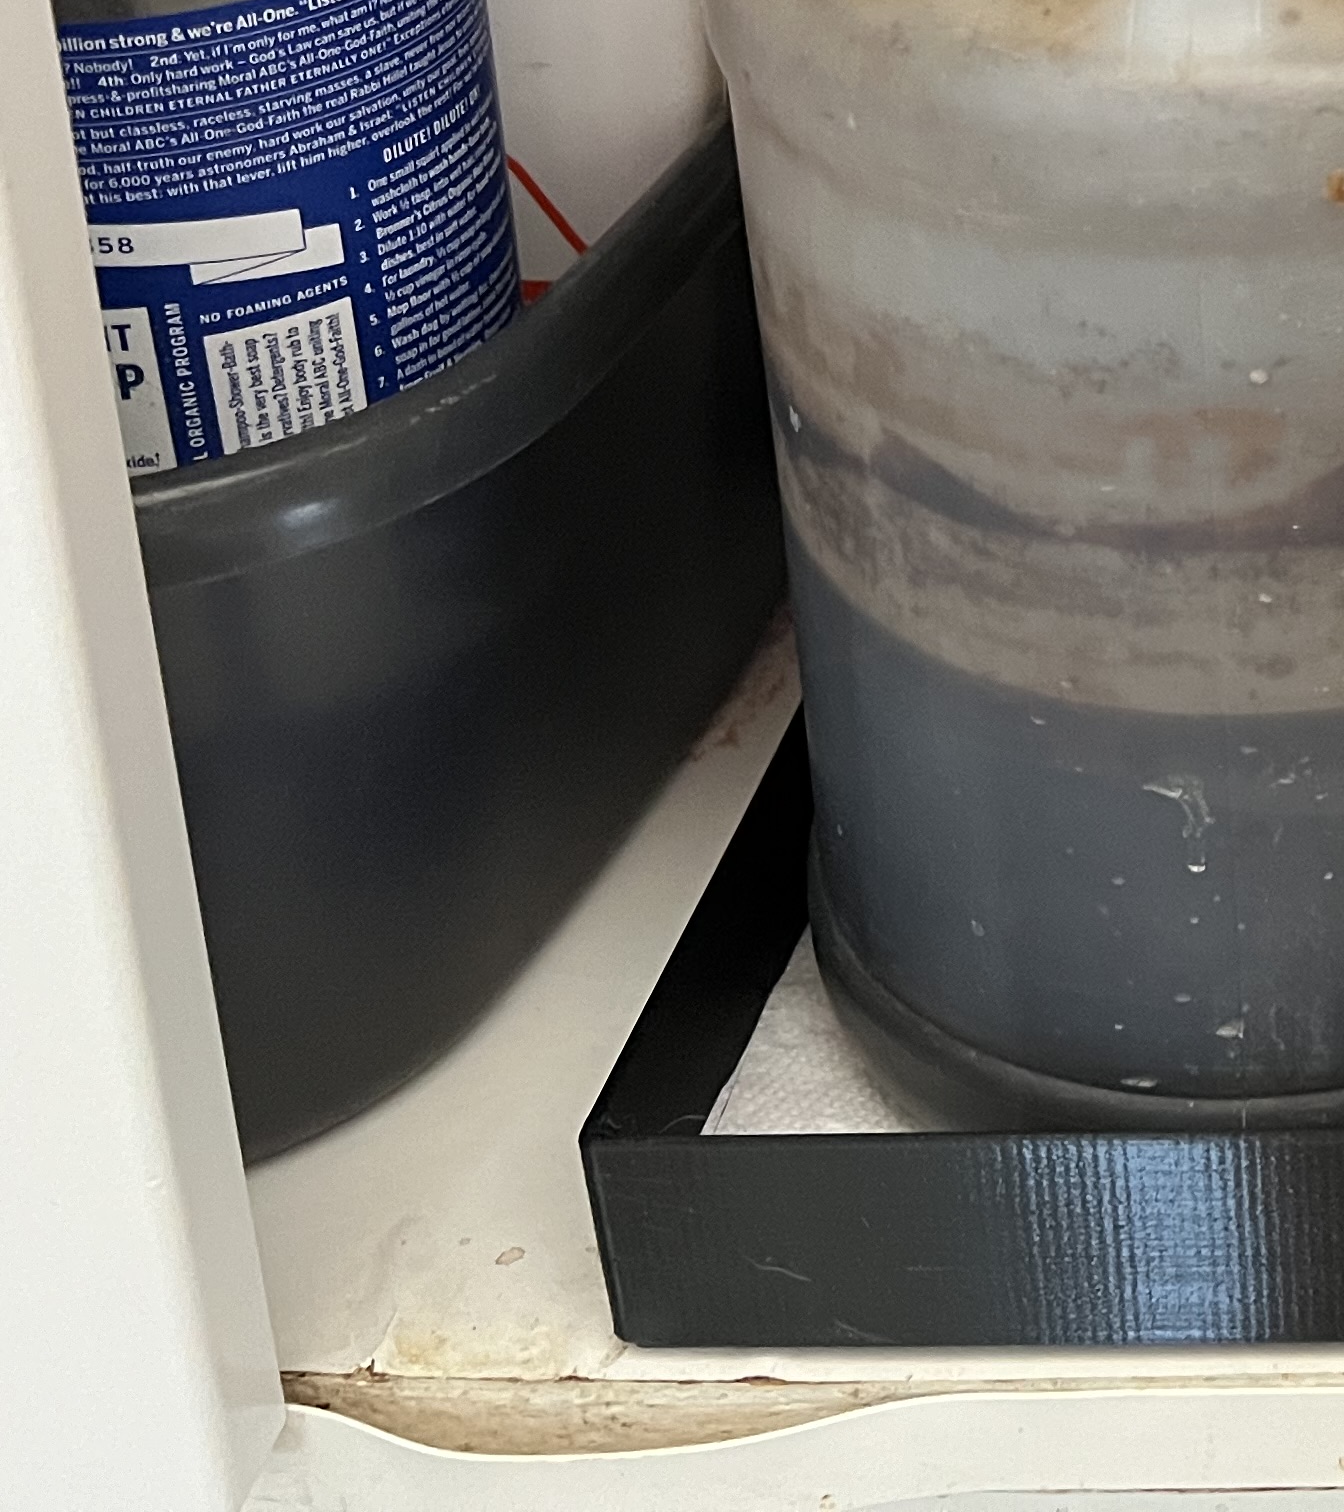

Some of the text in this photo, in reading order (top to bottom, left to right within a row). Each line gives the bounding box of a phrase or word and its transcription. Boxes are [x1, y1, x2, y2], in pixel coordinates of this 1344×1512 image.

[73, 59, 133, 74] Nobody!
[248, 35, 275, 53] only
[278, 30, 294, 43] for
[321, 9, 349, 29] what
[351, 4, 367, 19] am
[110, 33, 168, 47] strong
[171, 28, 185, 41] &
[187, 21, 233, 39] we're
[237, 5, 299, 30] All-One.
[131, 5, 396, 88] Only hard work God's Law can save but
[90, 54, 357, 118] CHILDREN ETERNAL FATHER ETERNALLY
[218, 59, 297, 88] Moral ABC's
[90, 127, 114, 140] but
[258, 89, 313, 114] starving
[91, 77, 381, 154] Moral ABC's the real Rabbi
[383, 127, 431, 163] DILUTE!
[433, 98, 469, 135] DILUTE!
[99, 189, 122, 203] his
[167, 180, 199, 197] with
[203, 176, 232, 191] that
[277, 157, 297, 174] lift
[300, 153, 325, 167] him
[372, 114, 416, 142] overlook
[155, 124, 357, 187] years astronomers Abraham &
[178, 116, 345, 165] our hard work our
[350, 160, 415, 199] 1. One small
[372, 207, 398, 223] Work
[377, 235, 406, 255] Dilute
[200, 276, 348, 325] NO FOAMING AGENTS
[387, 302, 409, 318] Mop
[165, 303, 205, 447] ORGANIC PROGRAM
